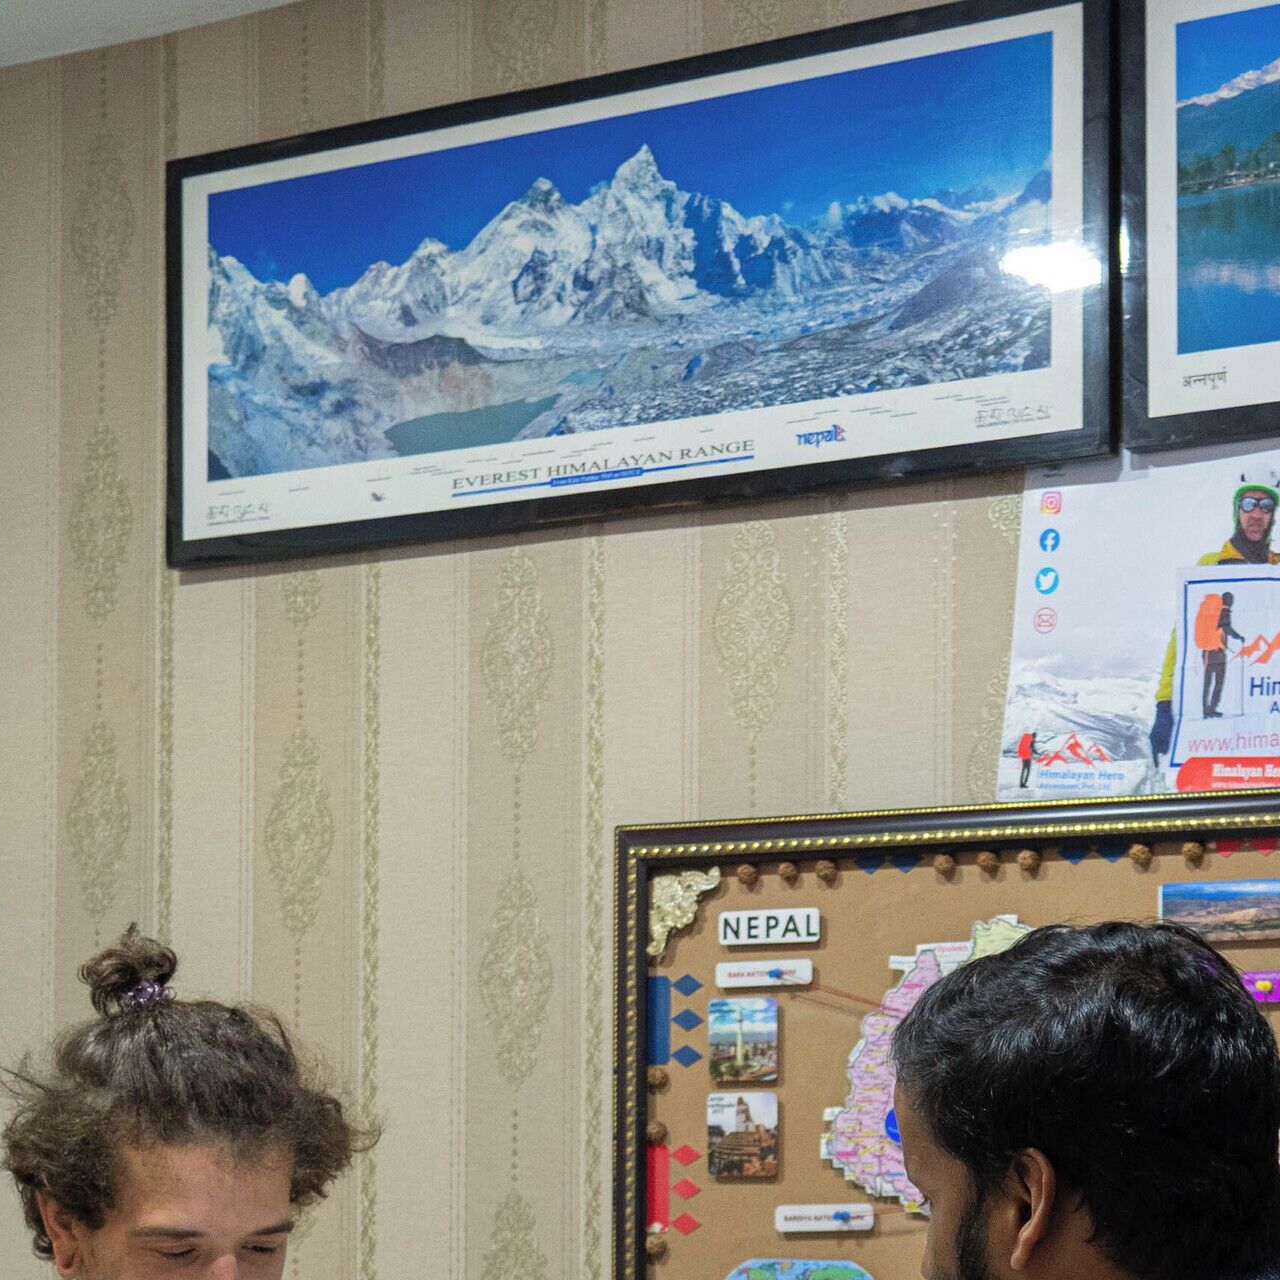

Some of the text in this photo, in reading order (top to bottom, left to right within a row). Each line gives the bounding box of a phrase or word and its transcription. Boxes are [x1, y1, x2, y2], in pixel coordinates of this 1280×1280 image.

[796, 424, 839, 448] nepal
[452, 467, 541, 490] EVEREST
[547, 449, 674, 477] HIMALAYAN
[679, 439, 755, 460] RANGE
[1212, 763, 1263, 780] Himalayan
[723, 914, 818, 940] NEPAL
